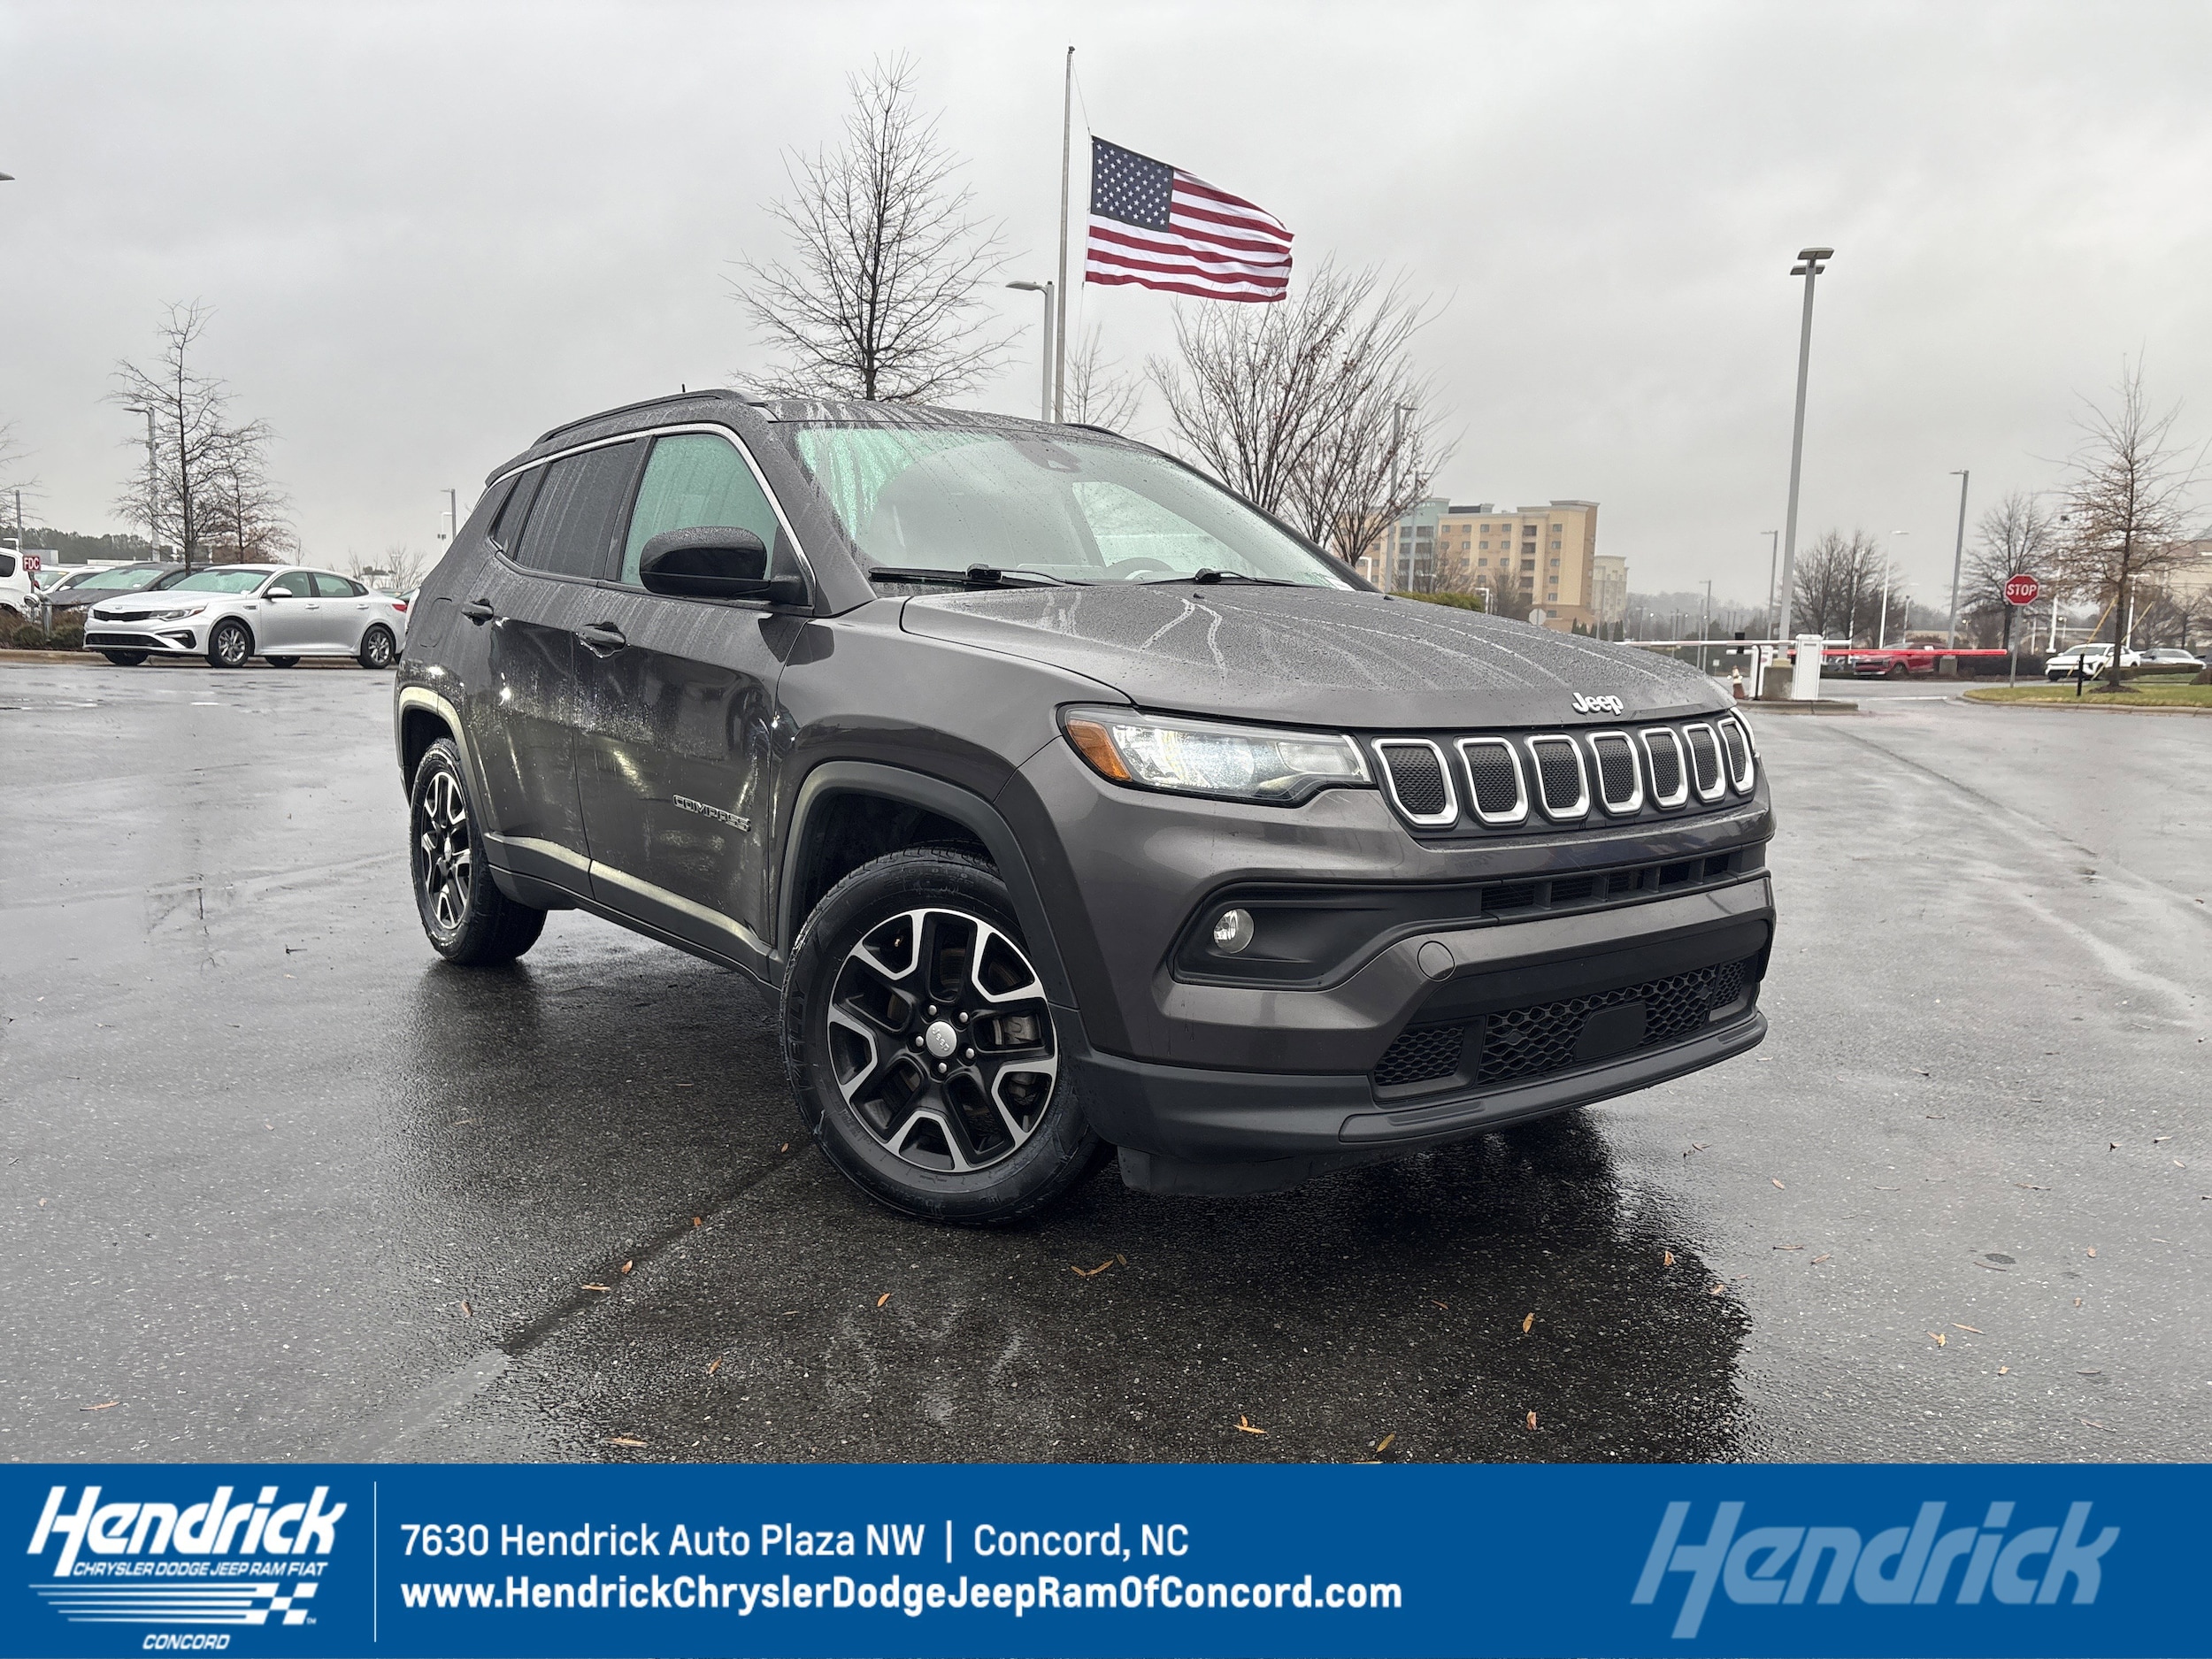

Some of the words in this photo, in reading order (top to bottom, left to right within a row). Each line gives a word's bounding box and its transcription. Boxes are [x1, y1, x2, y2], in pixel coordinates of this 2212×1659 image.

[24, 557, 40, 570] FDC
[2007, 583, 2037, 596] STOP
[1571, 692, 1624, 716] Jeep
[672, 794, 751, 833] COMPASS
[931, 1026, 951, 1052] Jeep
